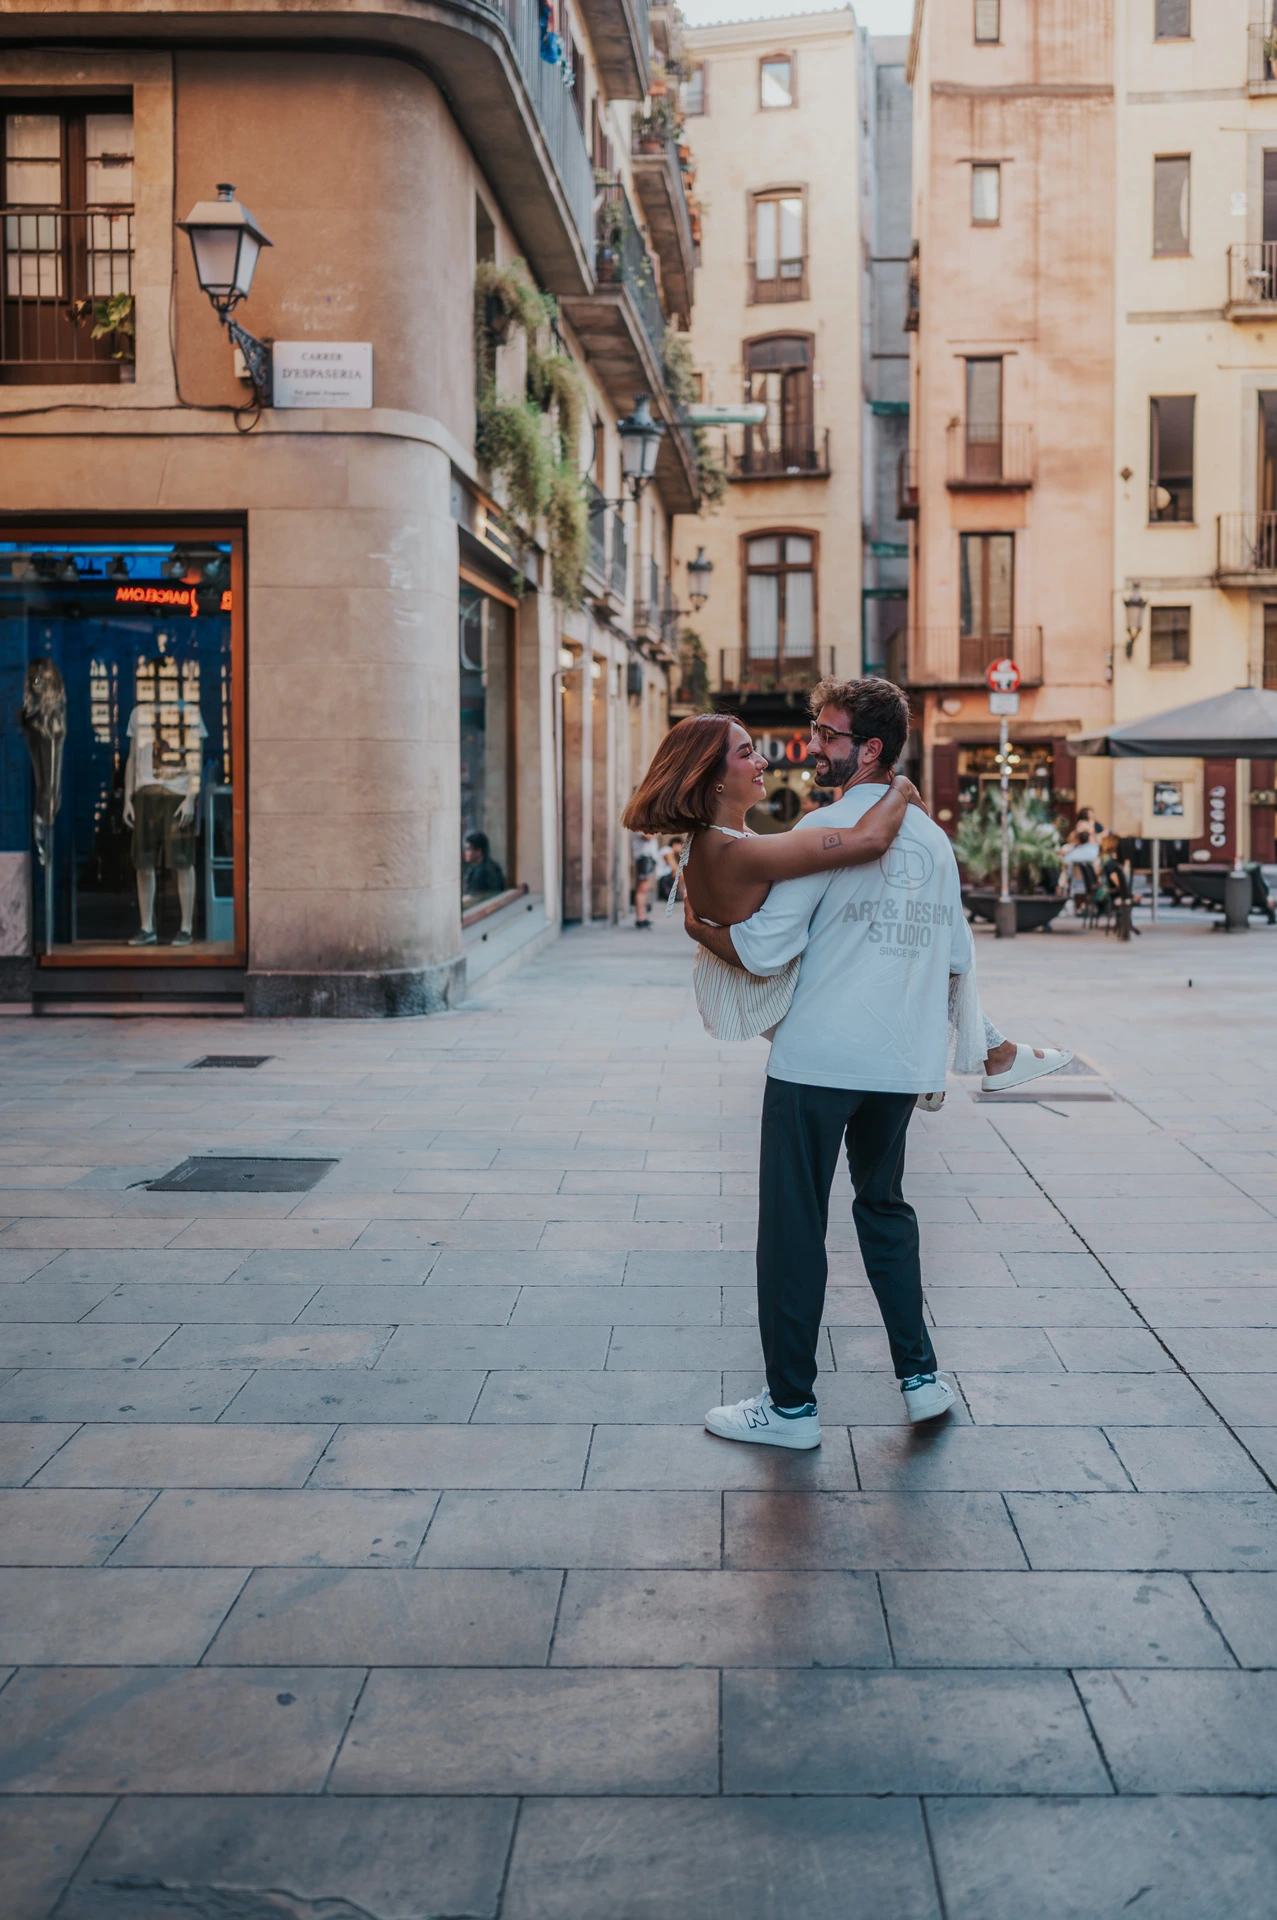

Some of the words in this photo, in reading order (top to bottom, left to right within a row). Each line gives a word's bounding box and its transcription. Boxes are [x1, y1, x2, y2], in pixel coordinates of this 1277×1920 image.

[881, 898, 899, 919] &
[868, 921, 932, 947] STUDIO
[879, 946, 908, 958] SINCE
